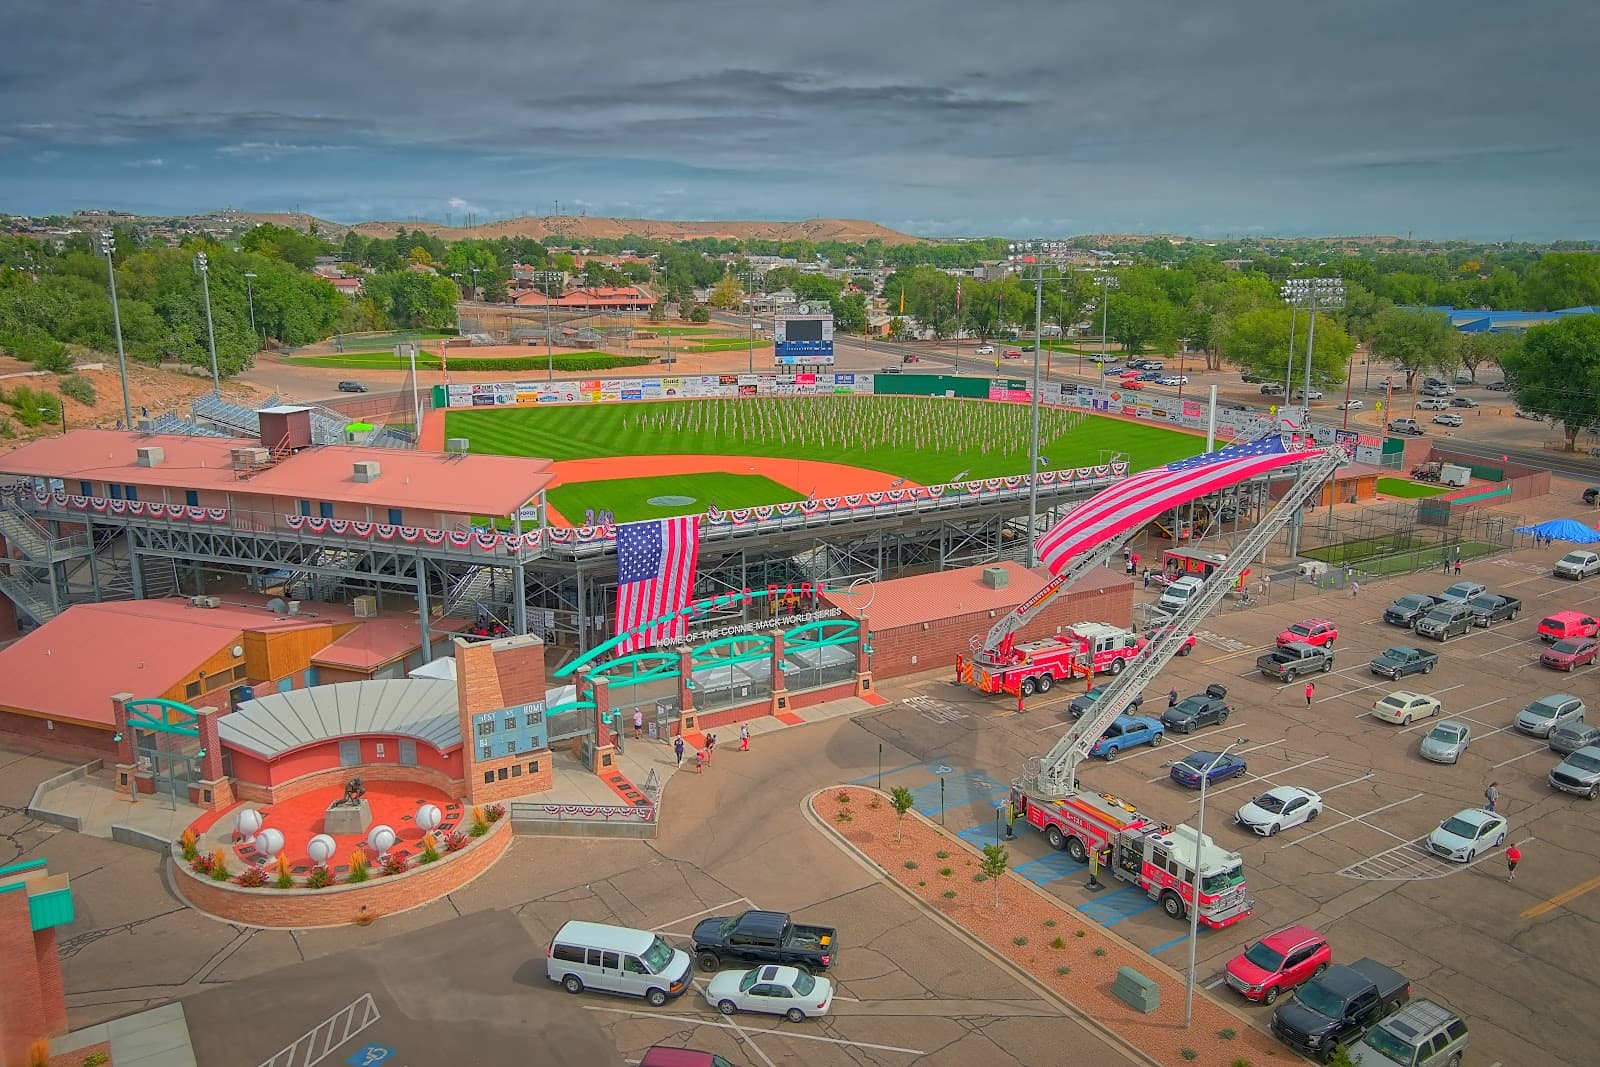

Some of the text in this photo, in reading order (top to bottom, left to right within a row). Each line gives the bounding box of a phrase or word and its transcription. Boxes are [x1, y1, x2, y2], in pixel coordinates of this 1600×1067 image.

[767, 581, 828, 602] PARK
[1020, 576, 1064, 612] FARMINGTON FIRE
[656, 606, 842, 648] HOME OF THE CONNIE MACK WORLD SERIES
[1105, 692, 1131, 720] DISTRICT
